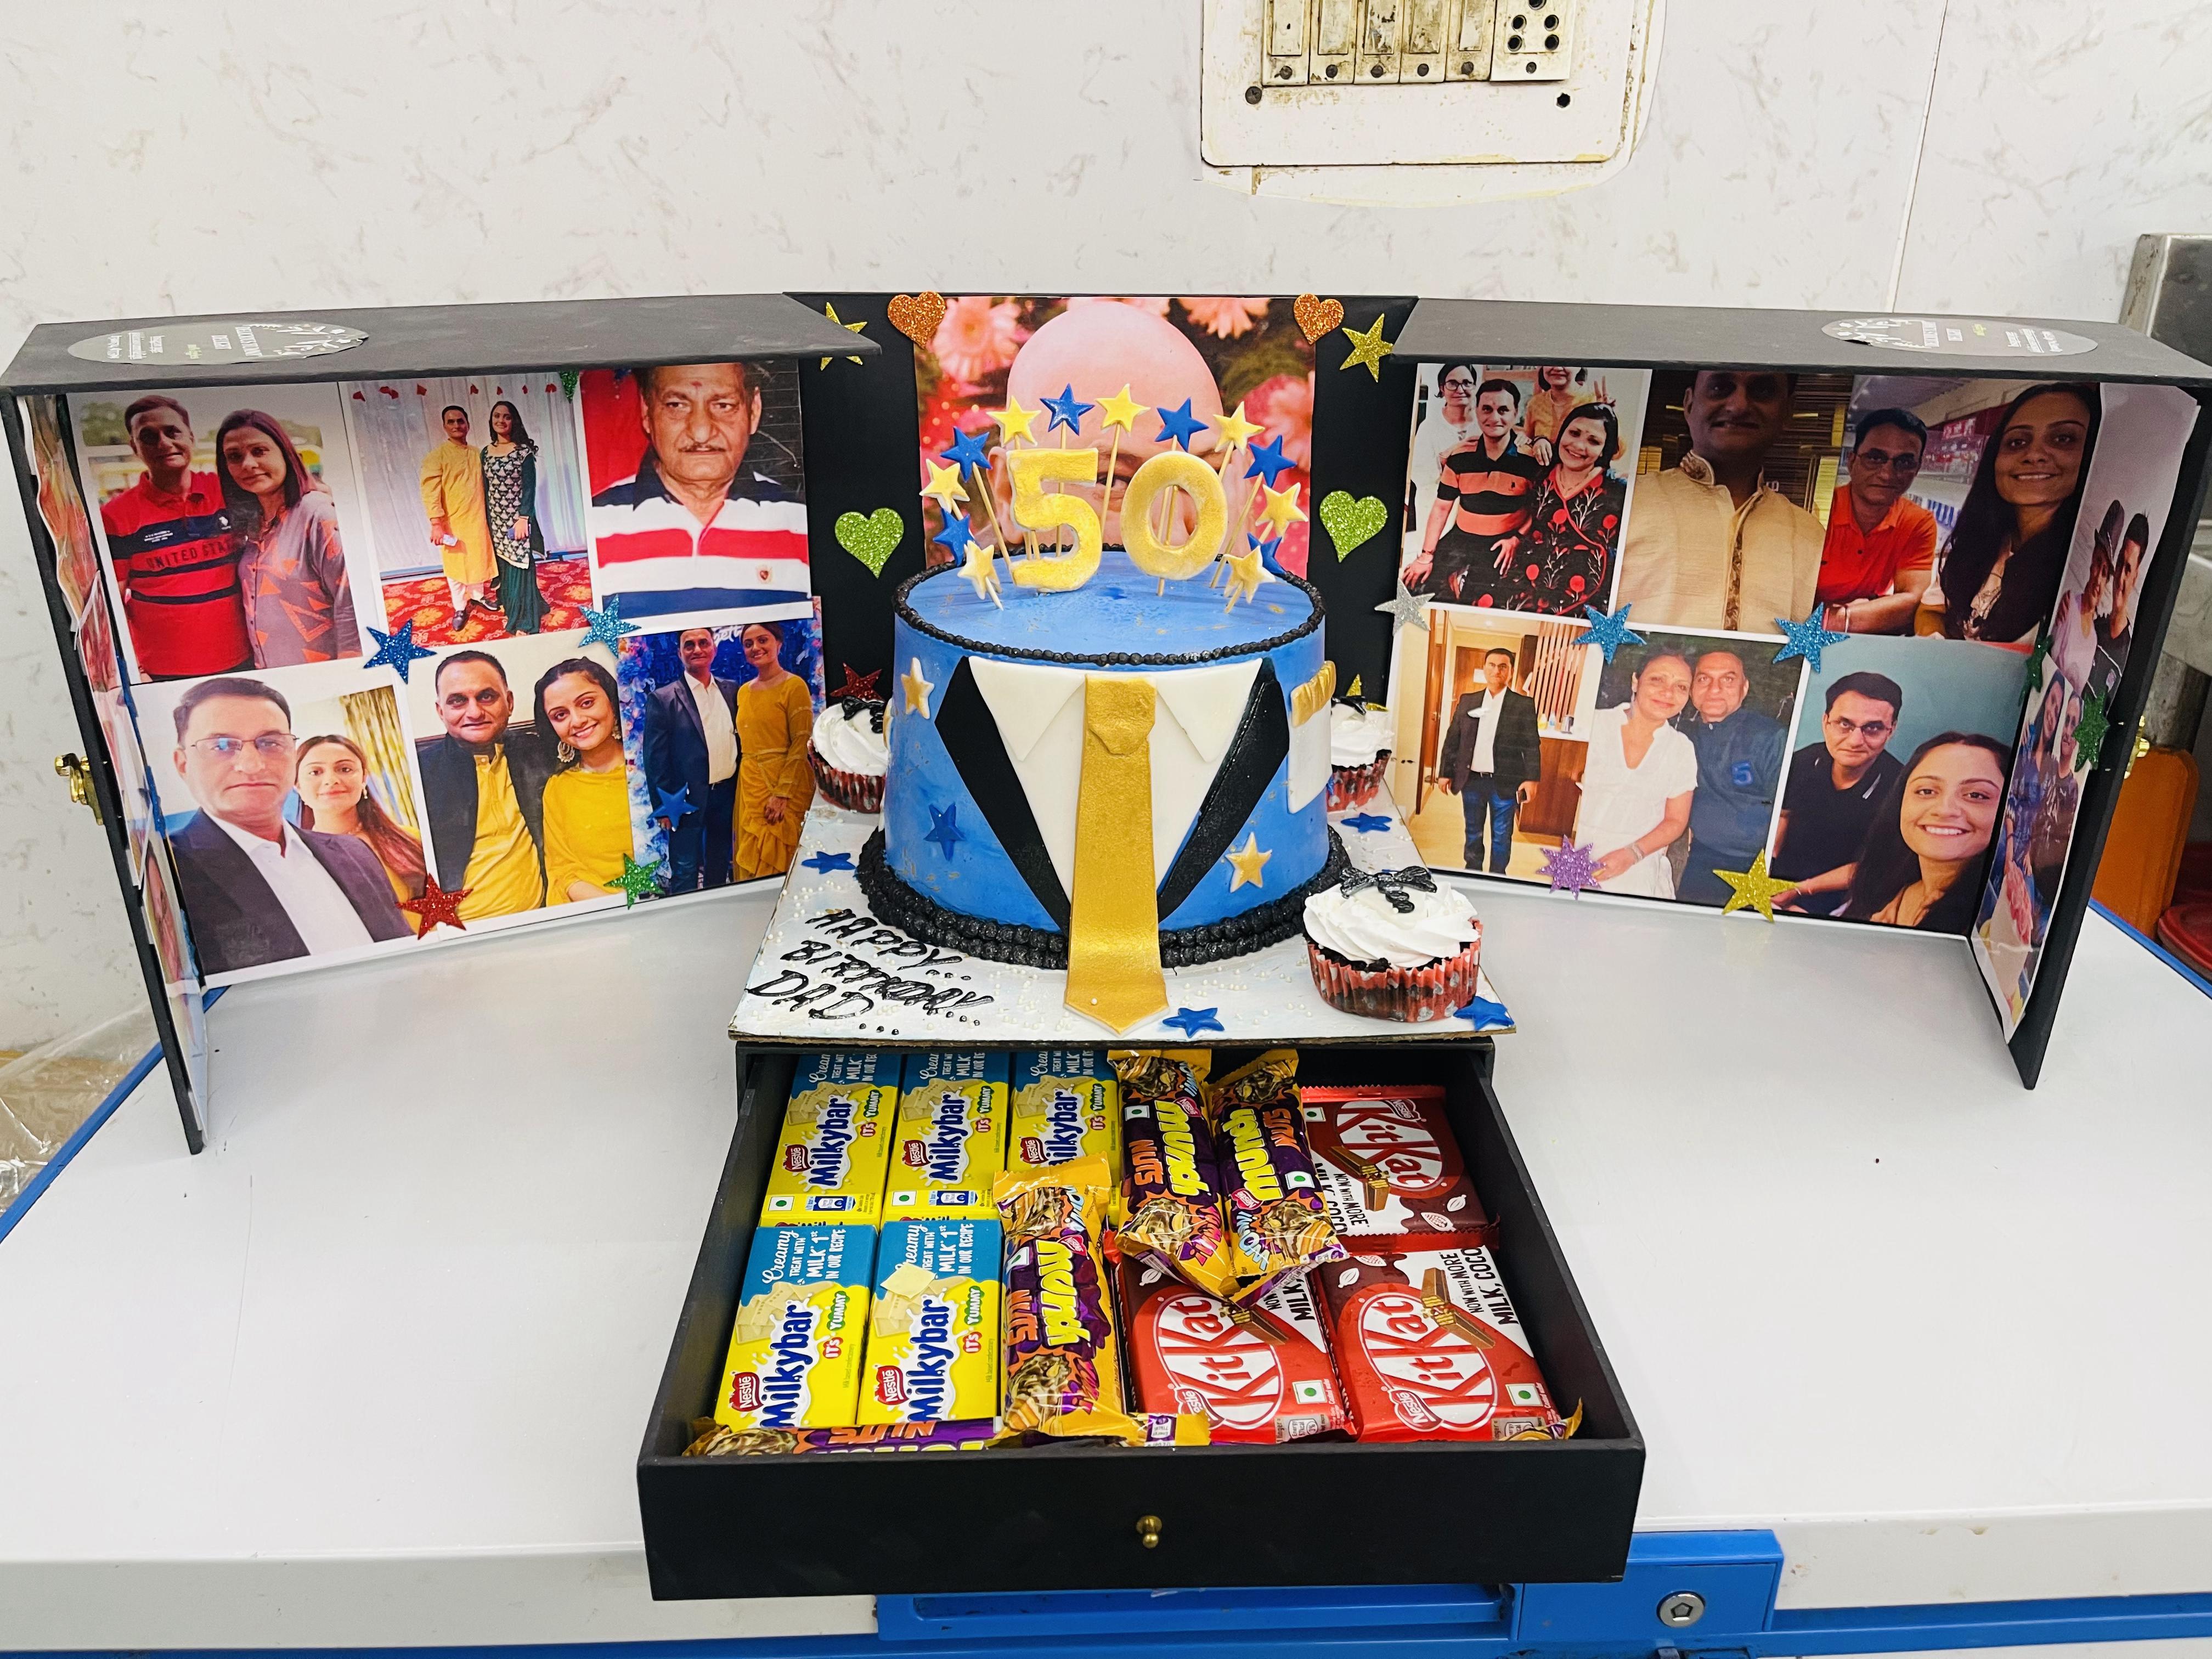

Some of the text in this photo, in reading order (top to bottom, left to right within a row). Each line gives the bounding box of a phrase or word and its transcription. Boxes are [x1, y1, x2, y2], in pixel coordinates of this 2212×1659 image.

[1006, 448, 1228, 593] 50
[146, 548, 198, 569] UNITED
[1731, 761, 1753, 786] 5
[846, 1059, 862, 1080] MILK
[956, 1056, 970, 1076] MILK
[1065, 1053, 1080, 1073] MILK
[866, 1091, 879, 1117] YUMMY
[979, 1087, 991, 1113] YUMMY
[1092, 1085, 1103, 1110] YUMMY
[809, 1098, 852, 1186] Milkybar
[928, 1094, 968, 1181] Milkybar
[1263, 1108, 1301, 1152] NUTS
[1336, 1107, 1442, 1185] KitKat
[1129, 1139, 1164, 1186] NUTS
[1333, 1173, 1368, 1226] NOW WITH MORE
[762, 1230, 799, 1284] Creamy
[789, 1238, 806, 1277] TREAT WITH
[810, 1231, 830, 1244] 1st
[825, 1229, 847, 1279] IN OUR RECIPE
[895, 1224, 928, 1269] reamy
[922, 1232, 935, 1271] TREAT WITH
[939, 1225, 958, 1272] MILK 1st
[958, 1223, 974, 1274] IN OUR RECIPE
[806, 1249, 826, 1277] MILK
[1441, 1252, 1484, 1313] NOW WITH MORE
[830, 1293, 847, 1330] YUMMY
[967, 1288, 980, 1324] YUMMY
[1008, 1289, 1039, 1347] NUTS
[1263, 1293, 1282, 1311] NOW
[760, 1305, 813, 1427] Milkybar
[906, 1299, 954, 1421] Milkybar
[1159, 1299, 1280, 1408] KitKat
[1364, 1301, 1492, 1406] KitKat
